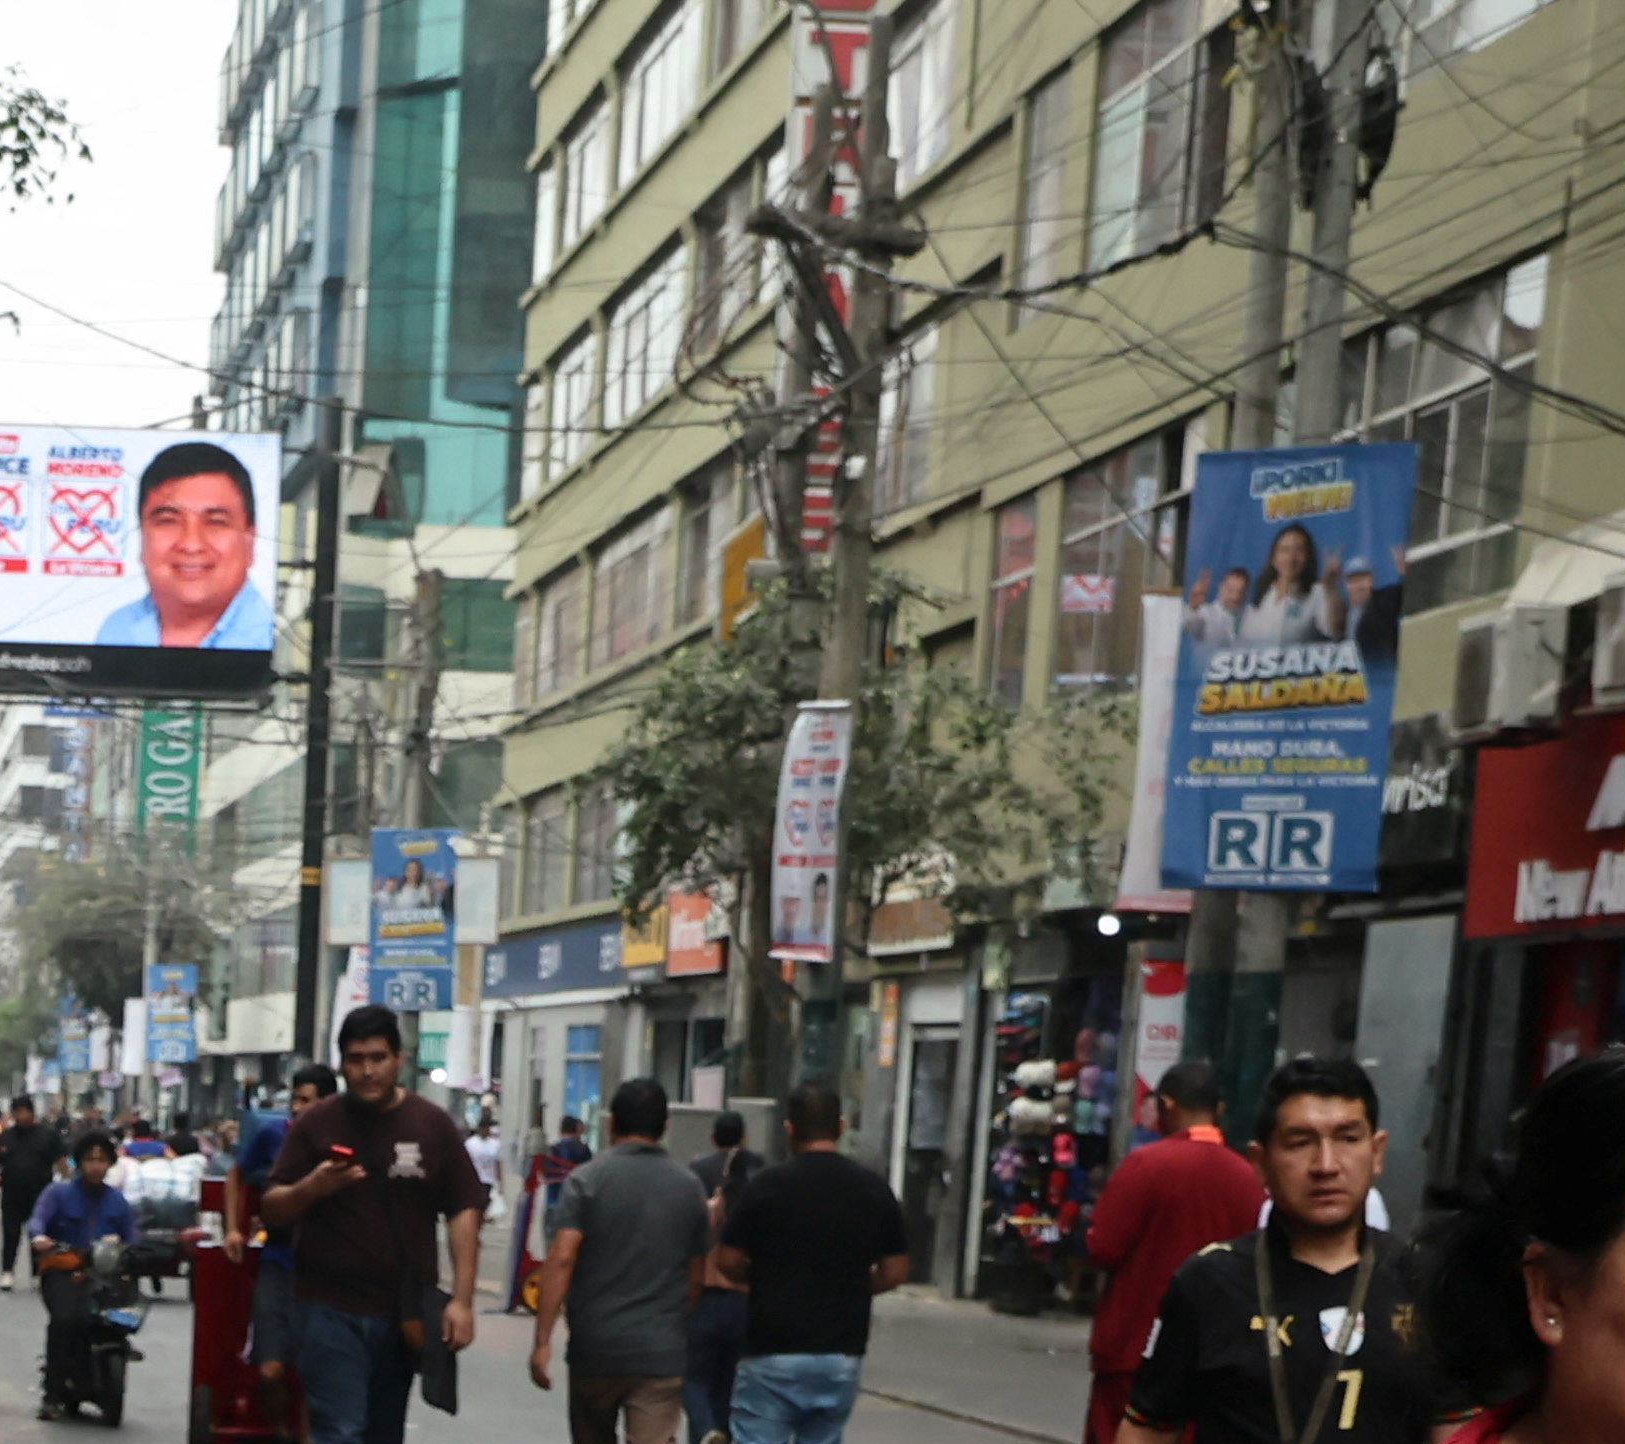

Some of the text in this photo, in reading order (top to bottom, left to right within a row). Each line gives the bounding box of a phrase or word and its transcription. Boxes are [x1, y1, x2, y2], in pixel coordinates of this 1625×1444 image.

[47, 446, 124, 462] ALBERTO
[47, 462, 125, 478] MORENO
[1208, 642, 1359, 679] SUSANA
[1196, 673, 1368, 715] SALDAÑA
[1514, 858, 1592, 925] New
